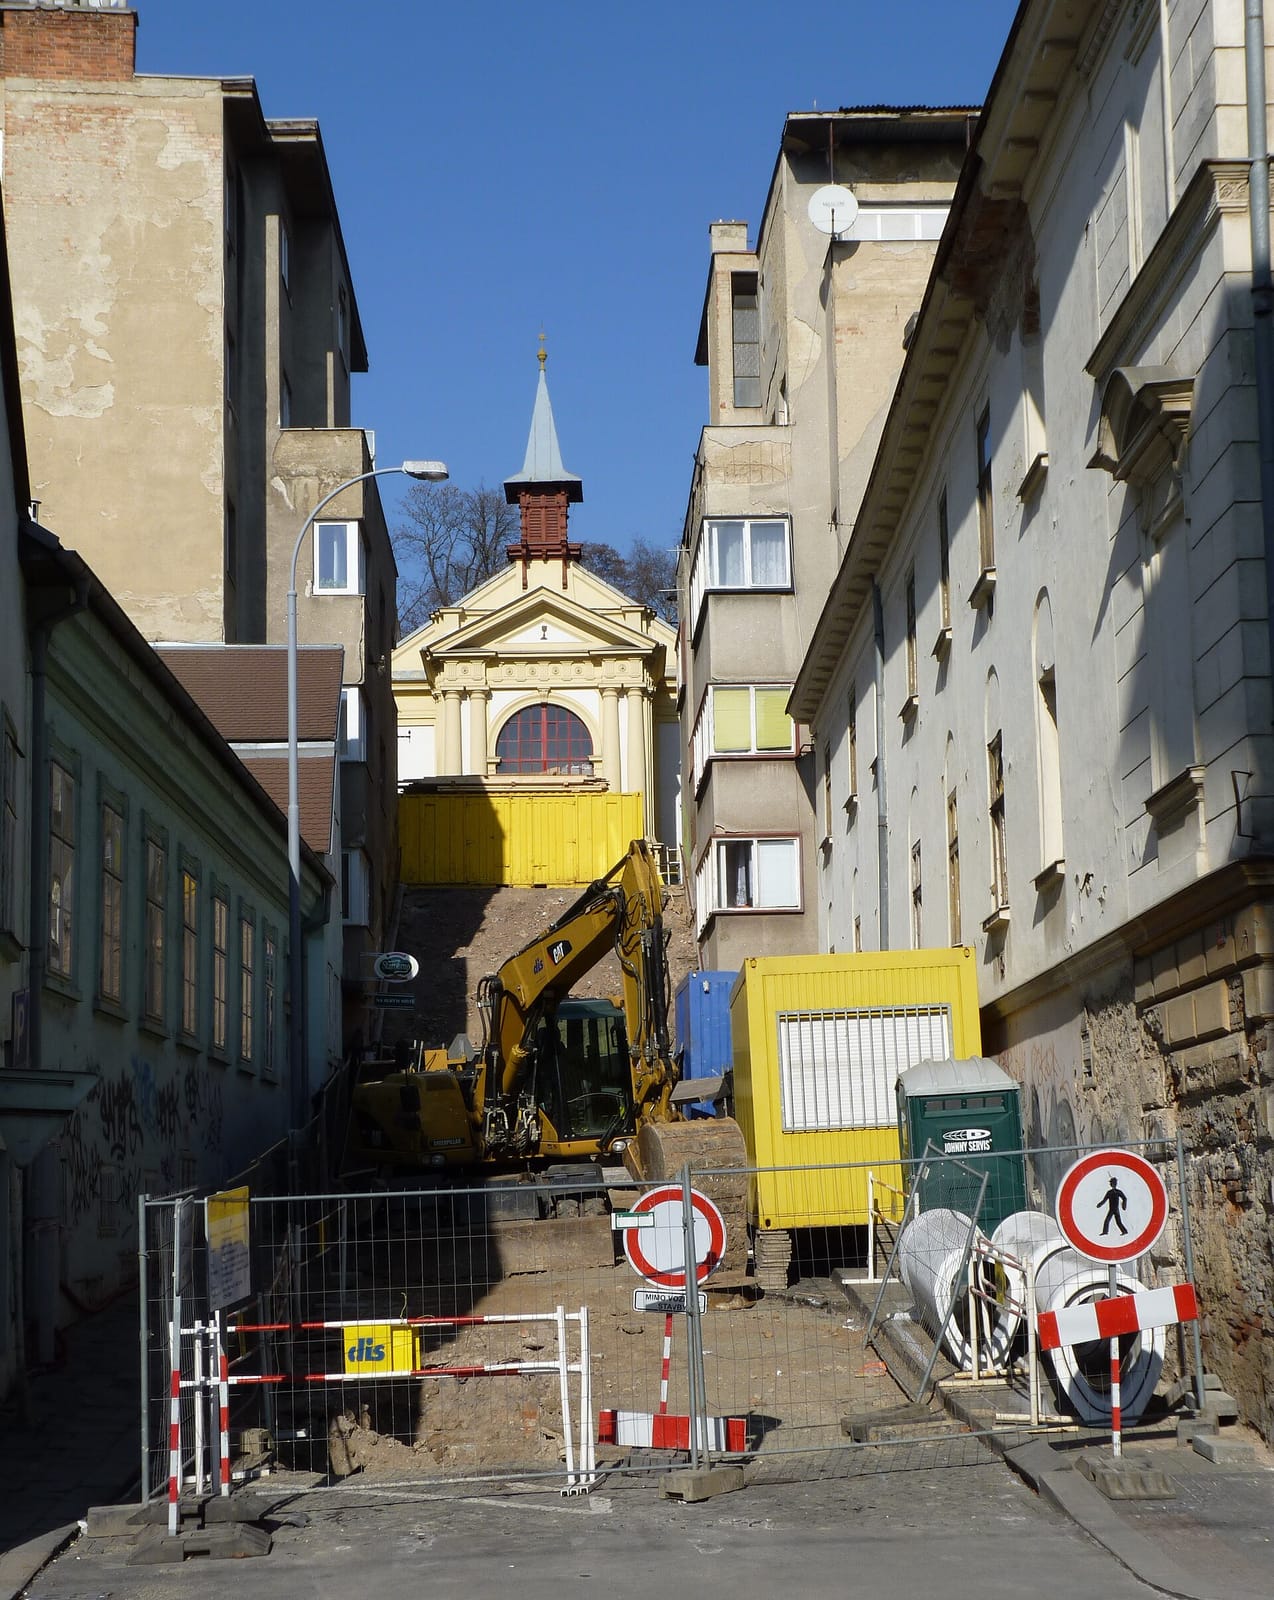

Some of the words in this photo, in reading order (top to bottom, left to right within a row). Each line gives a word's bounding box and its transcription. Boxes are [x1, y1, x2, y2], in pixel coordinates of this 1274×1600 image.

[552, 942, 565, 964] CAT
[944, 1141, 967, 1154] JOHNNY
[968, 1139, 991, 1152] SERVIS
[347, 1337, 386, 1362] dis
